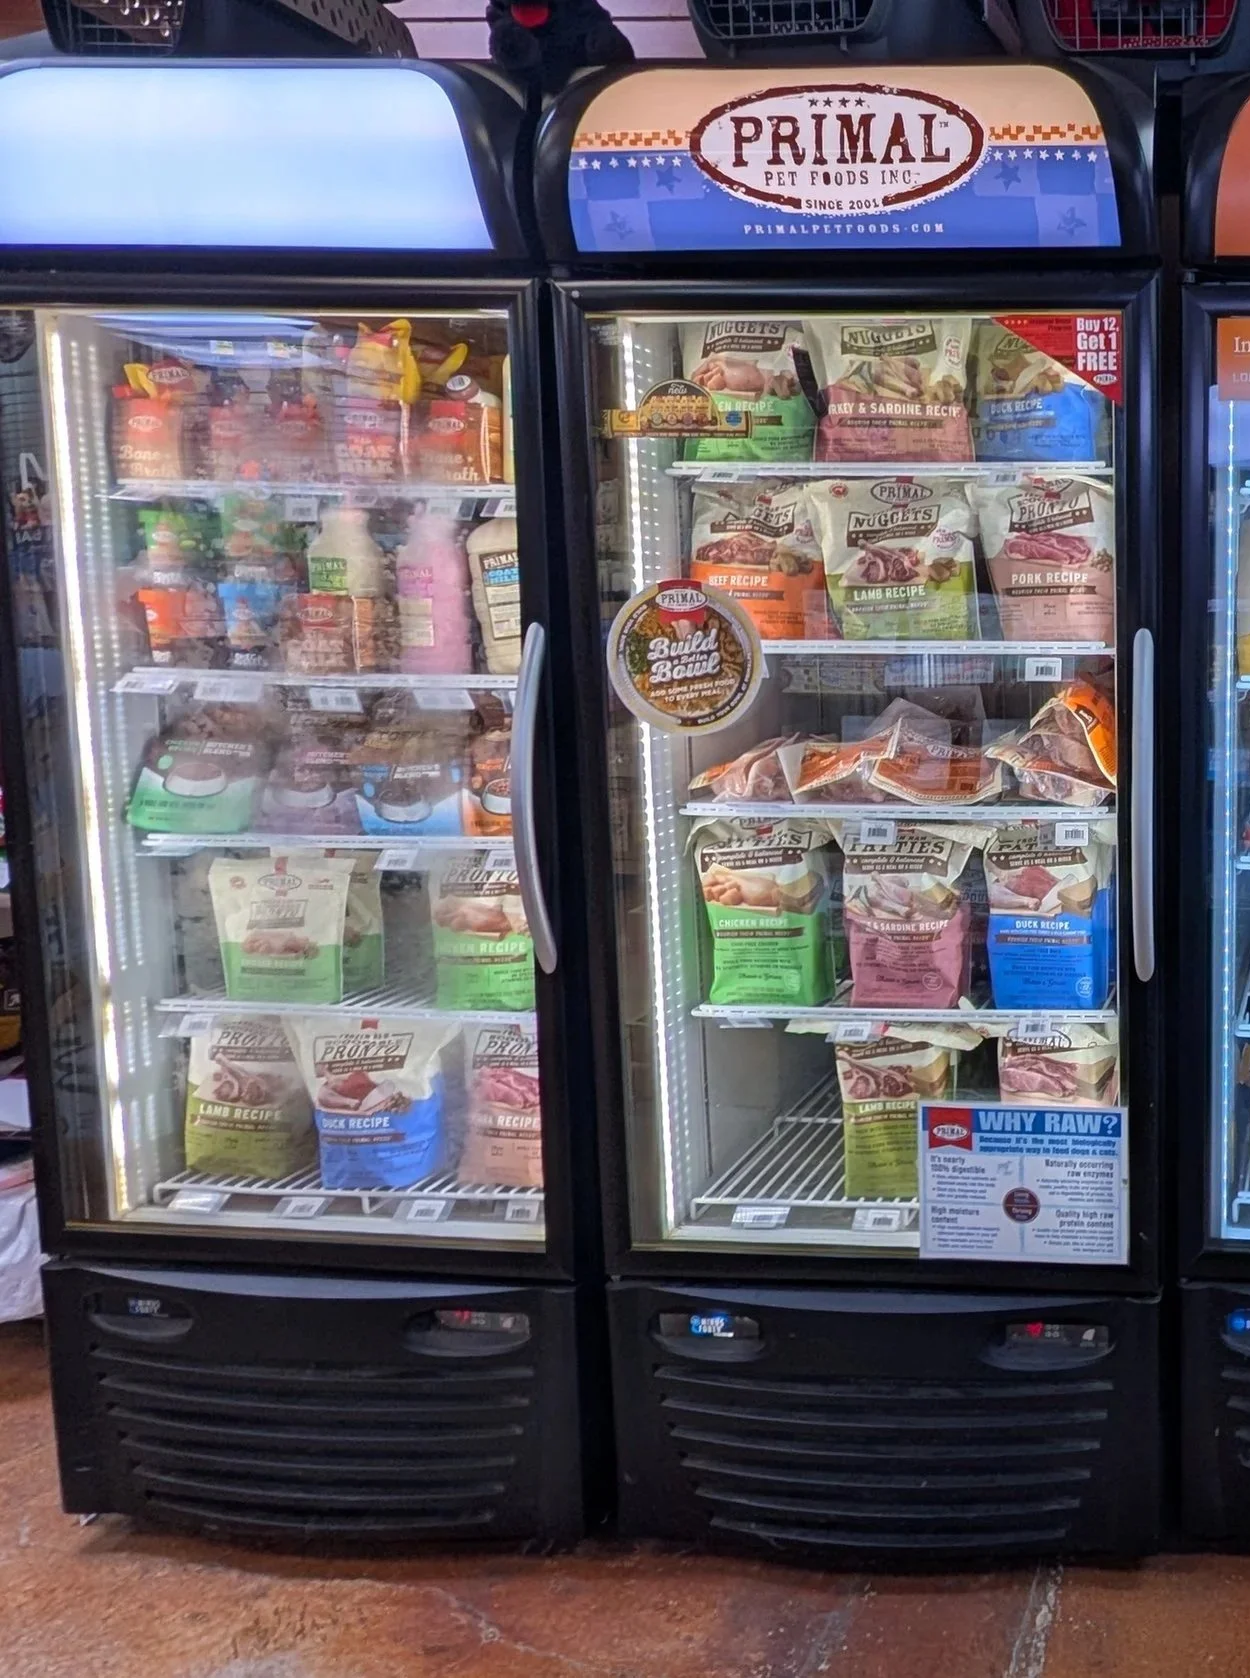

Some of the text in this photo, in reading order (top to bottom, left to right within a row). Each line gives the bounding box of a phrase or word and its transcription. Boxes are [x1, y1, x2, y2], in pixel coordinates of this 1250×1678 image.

[730, 112, 950, 167] PRIMAL
[764, 171, 798, 187] PET
[811, 169, 869, 185] FOODS
[805, 198, 880, 210] SINCE 2001
[743, 223, 945, 235] PRIMALPETFOODS.COM
[709, 321, 781, 342] NUGGETS
[1077, 332, 1117, 350] Get 1
[1077, 352, 1117, 371] FREE
[735, 401, 774, 412] RECIPE
[879, 487, 926, 500] PRIMAL
[854, 508, 932, 528] NUGGETS
[709, 576, 768, 586] BEEF RECIPE
[1011, 572, 1088, 584] PORK RECIPE
[661, 594, 702, 604] PRIMAL
[853, 585, 926, 601] LAMB RECIPE
[647, 628, 720, 660] Build
[649, 652, 720, 684] Bowl
[668, 685, 688, 694] SOME
[689, 682, 713, 691] FRESH
[715, 679, 736, 687] FOOD
[1016, 920, 1070, 930] DUCK RECIPE
[323, 1044, 403, 1059] PRONTO
[859, 1100, 916, 1112] LAMB RECIPE
[200, 1105, 281, 1121] LAMB RECIPE
[323, 1116, 390, 1129] DUCK RECIPE
[978, 1111, 1117, 1134] WHY RAW?
[930, 1155, 965, 1166] It's nearly
[1045, 1159, 1114, 1170] Naturally occurring
[930, 1164, 985, 1175] 100% digestible
[1083, 1171, 1113, 1179] enzymes
[930, 1216, 958, 1224] content
[1056, 1209, 1080, 1219] Quality
[1082, 1210, 1098, 1219] high
[1059, 1220, 1085, 1228] protein
